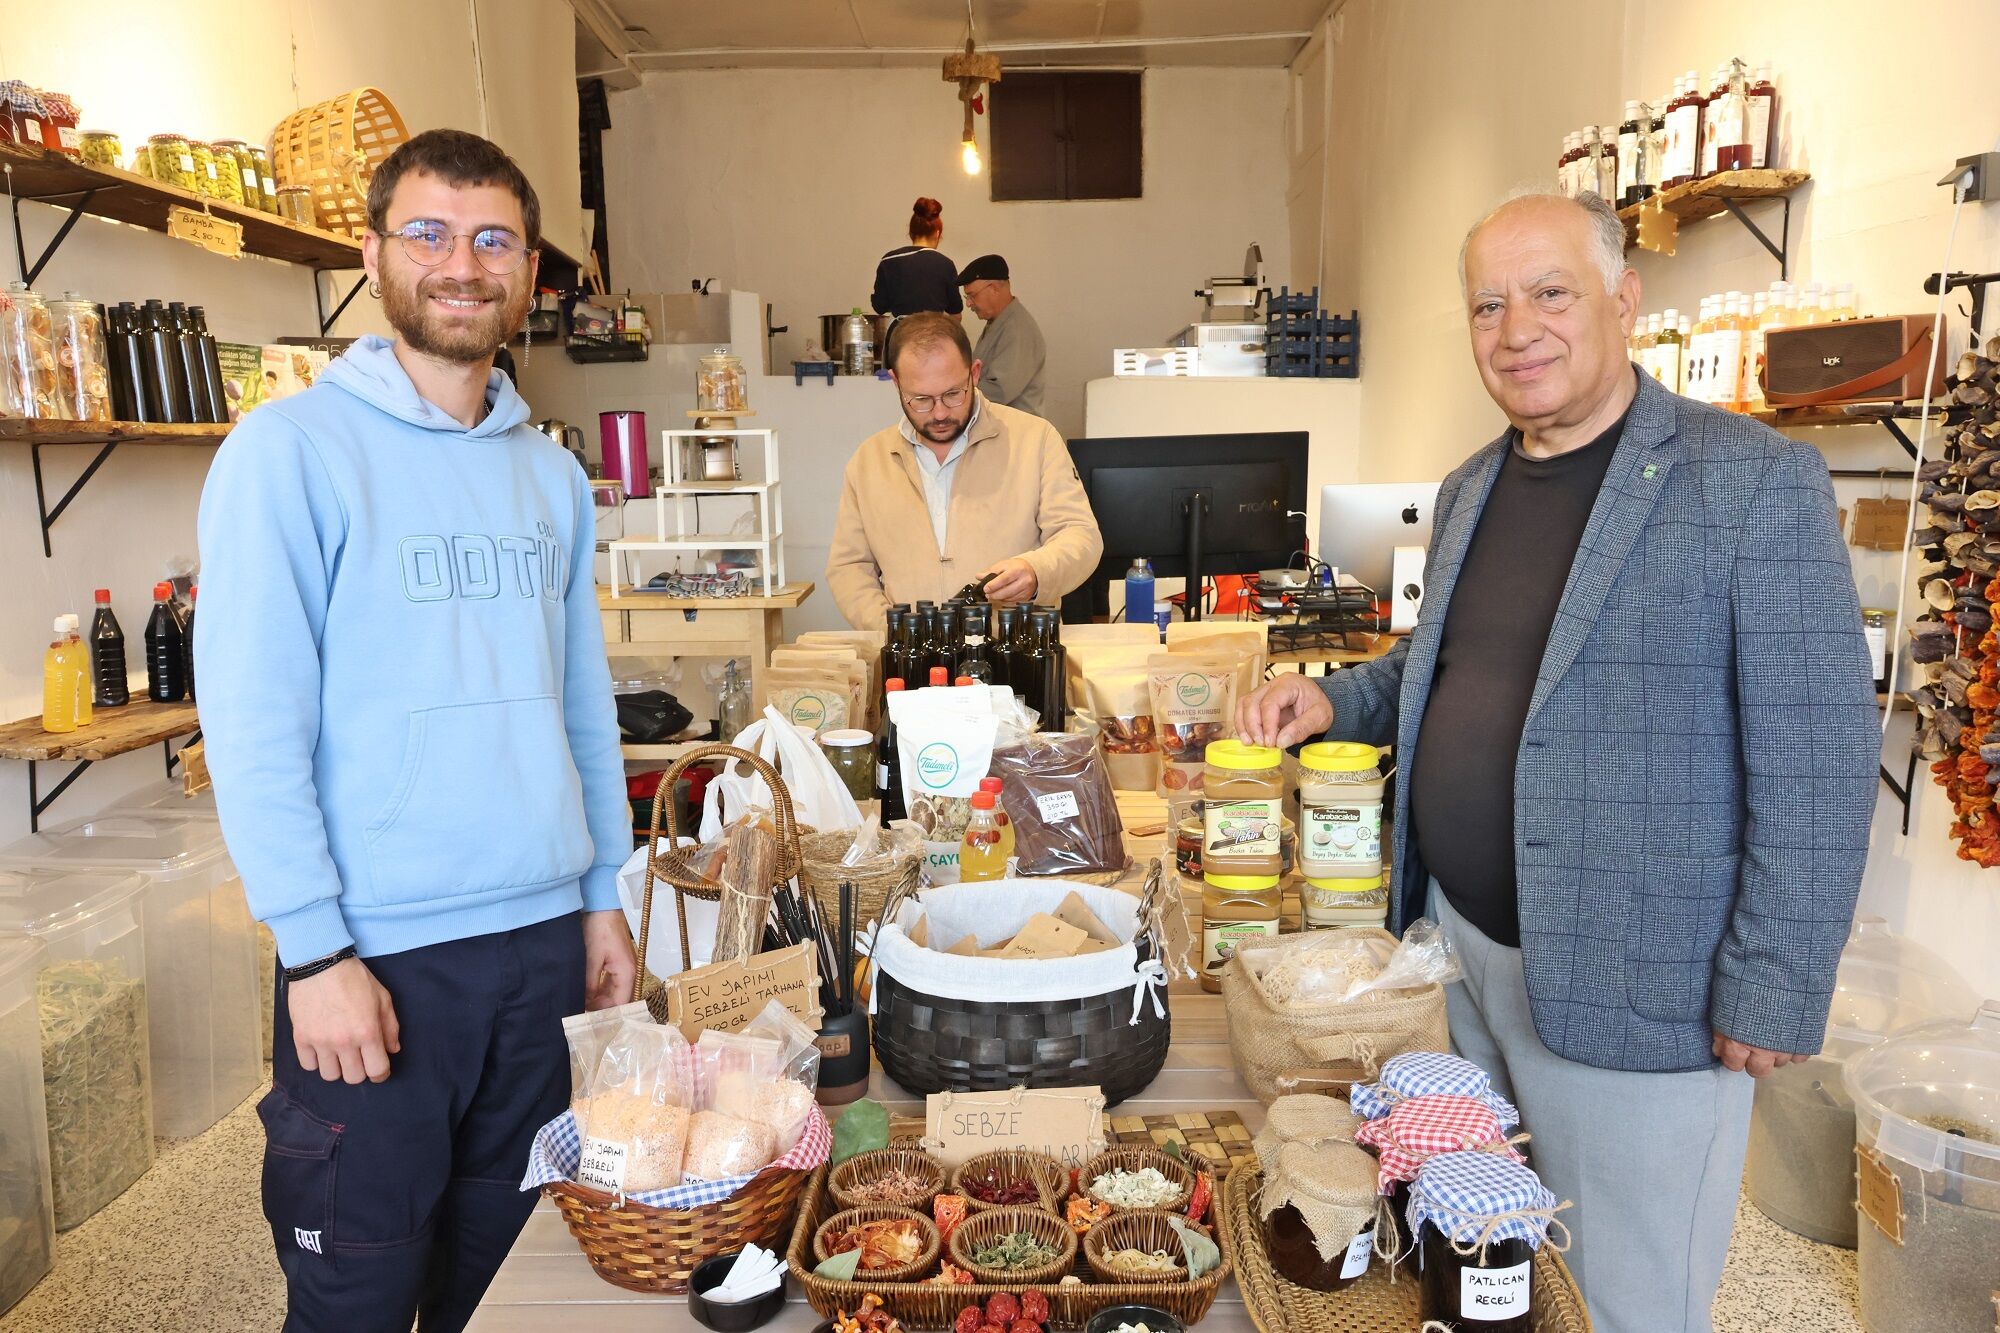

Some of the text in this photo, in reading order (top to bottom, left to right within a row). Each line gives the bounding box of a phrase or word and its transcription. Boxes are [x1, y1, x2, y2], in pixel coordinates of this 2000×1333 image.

[215, 236, 226, 245] TL
[398, 519, 560, 603] ODTÜ
[1168, 709, 1196, 717] DOMATES
[1233, 828, 1259, 844] Tahin
[688, 969, 776, 1003] EV YAPIMI
[756, 979, 805, 1000] TARHANA
[731, 1014, 748, 1027] GR
[953, 1111, 1022, 1138] SEBZE
[584, 1139, 624, 1157] EV YAPIMI
[581, 1172, 618, 1189] TARHANA
[294, 1227, 322, 1254] FIAT
[1468, 1274, 1525, 1287] PATLICAN
